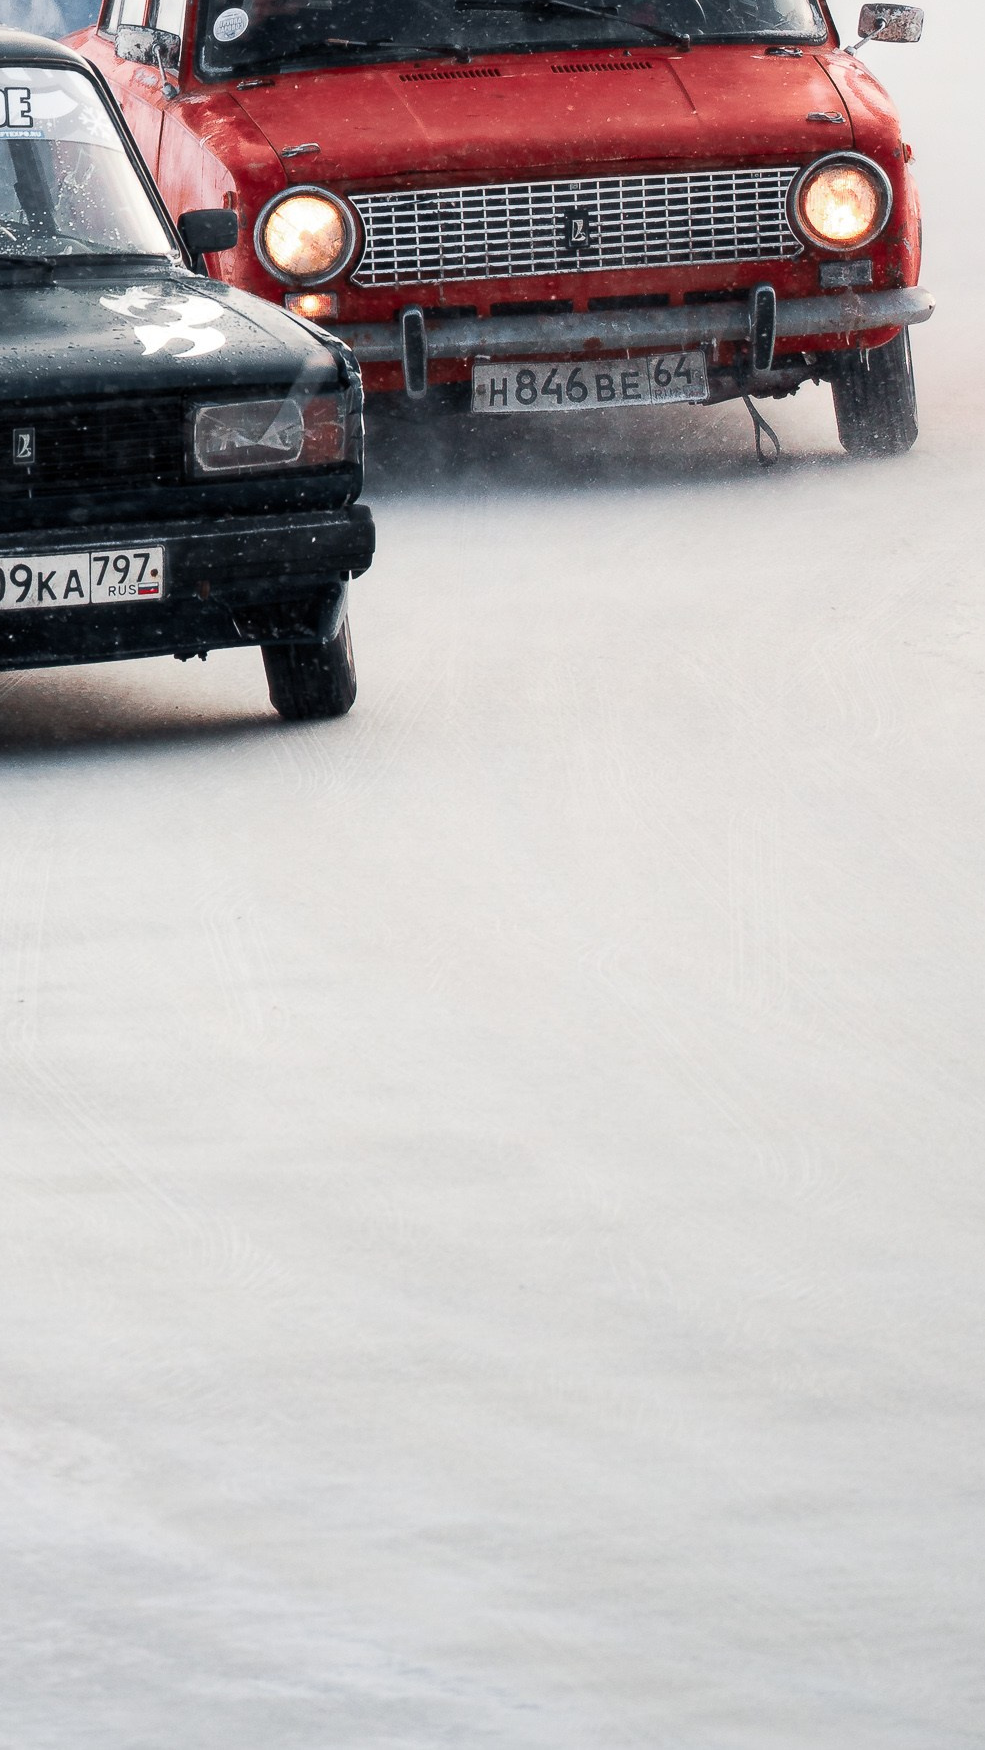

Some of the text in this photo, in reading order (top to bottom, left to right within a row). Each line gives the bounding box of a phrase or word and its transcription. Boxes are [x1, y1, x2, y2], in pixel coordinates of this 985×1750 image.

[653, 355, 692, 387] 64
[93, 553, 151, 586] 797
[108, 584, 137, 597] RUS
